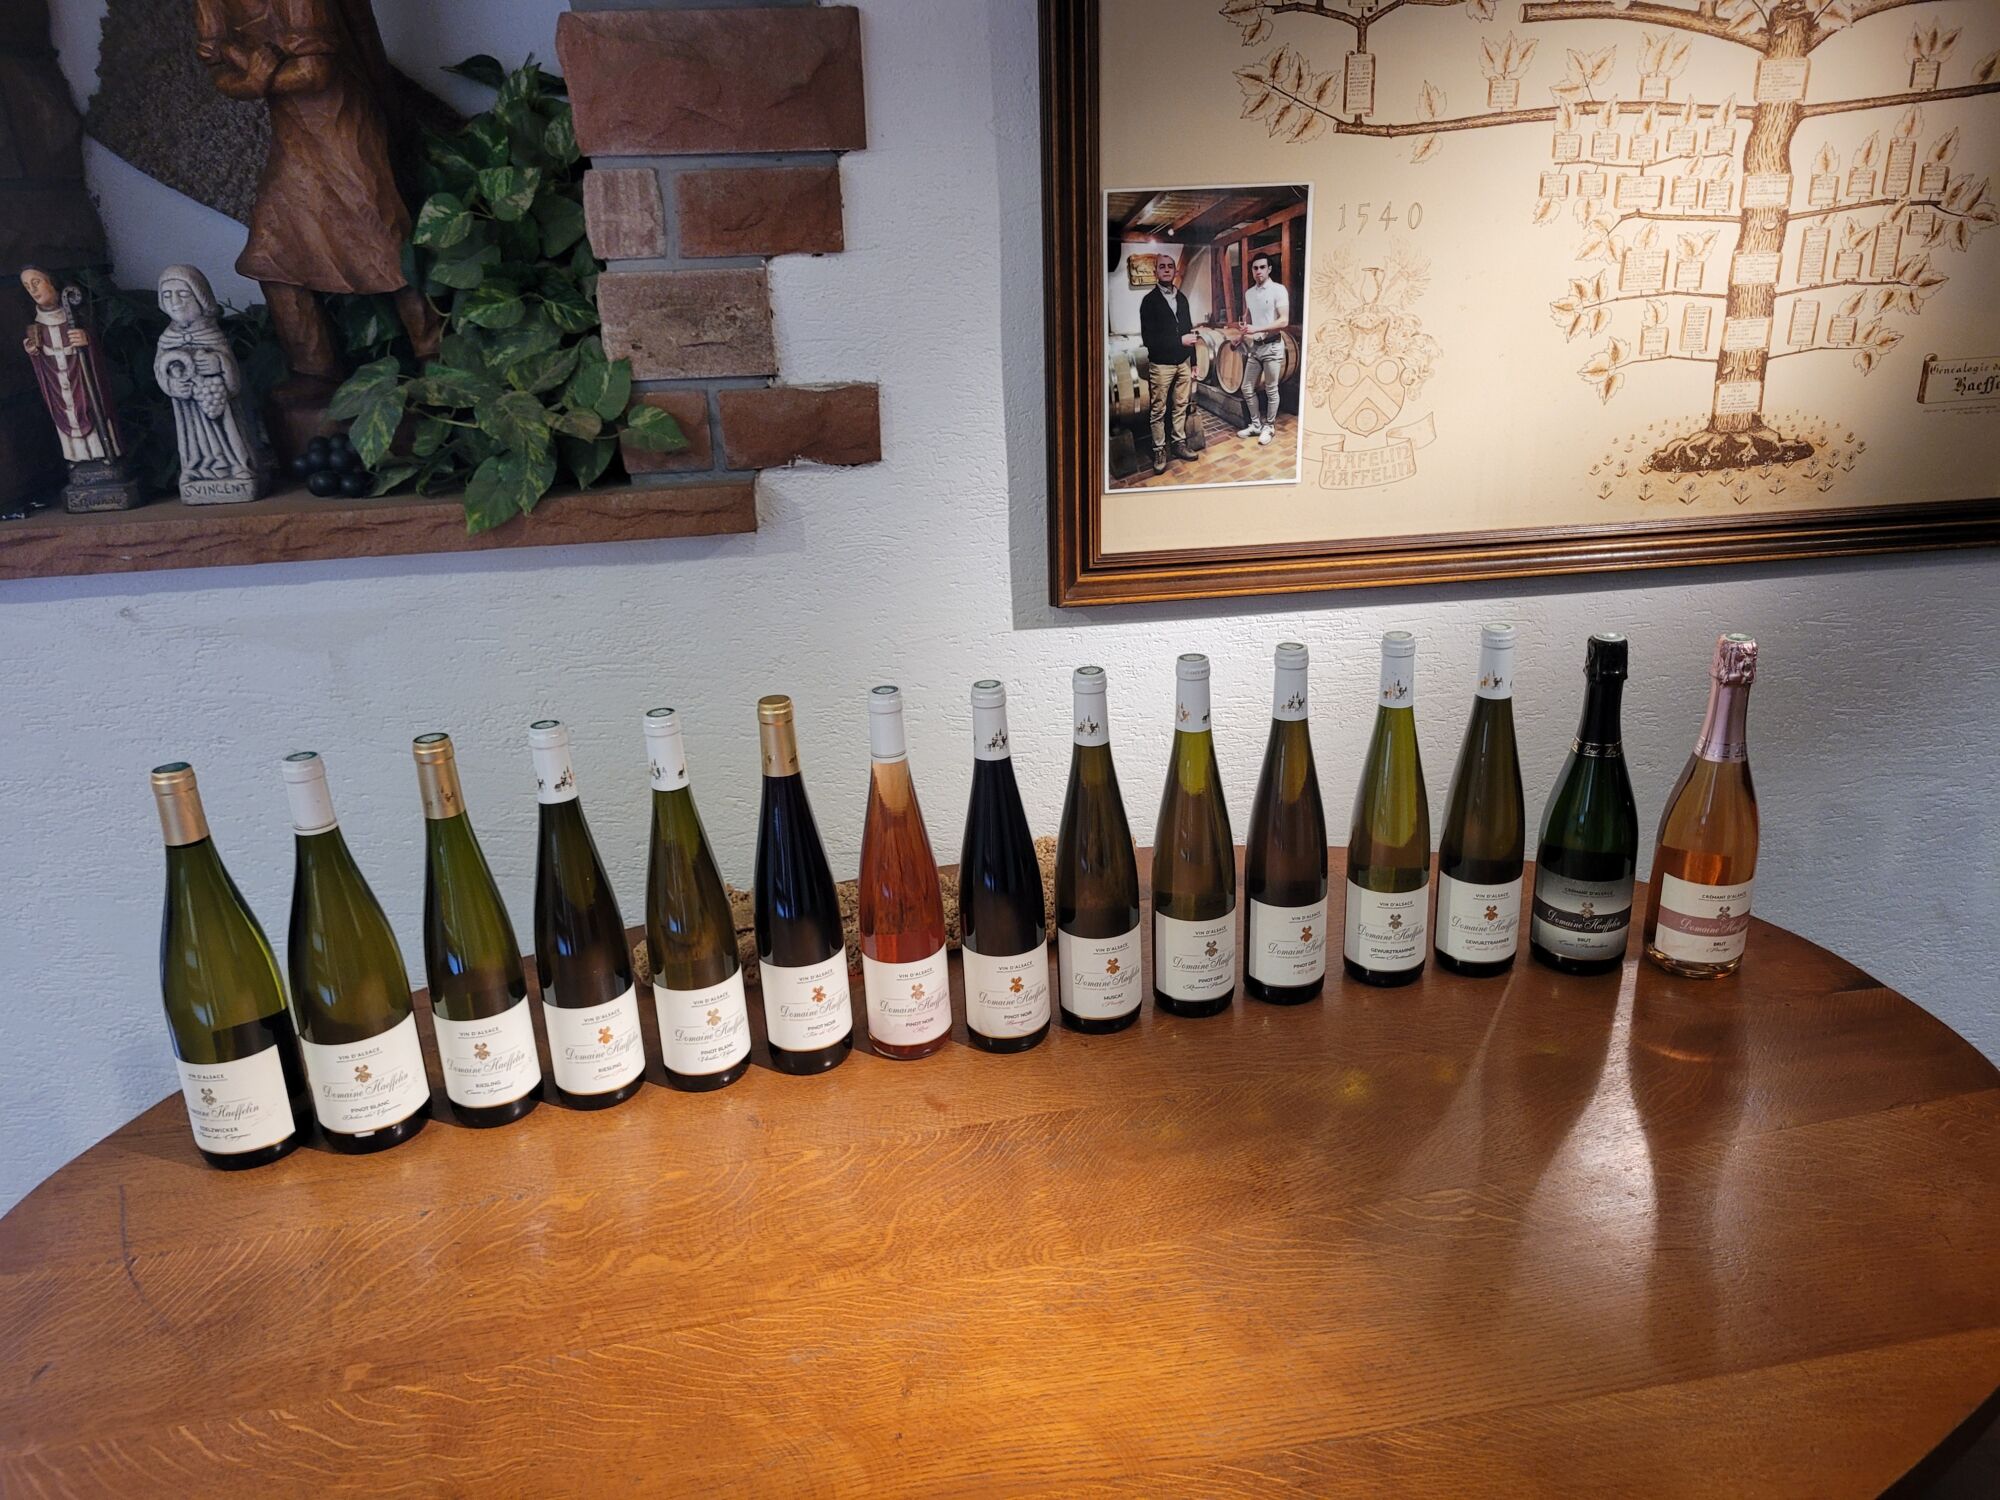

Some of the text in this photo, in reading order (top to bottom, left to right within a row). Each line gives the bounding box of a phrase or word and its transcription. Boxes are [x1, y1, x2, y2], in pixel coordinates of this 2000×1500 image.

[1337, 201, 1423, 235] 1540
[1451, 915, 1488, 932] Domaine
[1547, 909, 1583, 929] Domaine
[1679, 918, 1720, 934] Domaine
[1357, 924, 1393, 941] Domaine
[1267, 942, 1304, 956] Domaine
[1173, 956, 1210, 970] Domaine
[1074, 973, 1111, 988] Domaine
[978, 991, 1016, 1006] Domaine
[1103, 992, 1124, 1000] MUSCAT
[780, 1004, 818, 1018] Domaine
[880, 1000, 917, 1014] Domaine
[1020, 1010, 1033, 1018] NOIR
[824, 1019, 836, 1028] NOIR
[674, 1029, 713, 1042] Domaine
[565, 1047, 605, 1060] Domaine
[446, 1058, 482, 1074] Domaine
[322, 1084, 364, 1098] Domaine
[350, 1105, 369, 1113] PINOT
[369, 1099, 390, 1110] BLANC
